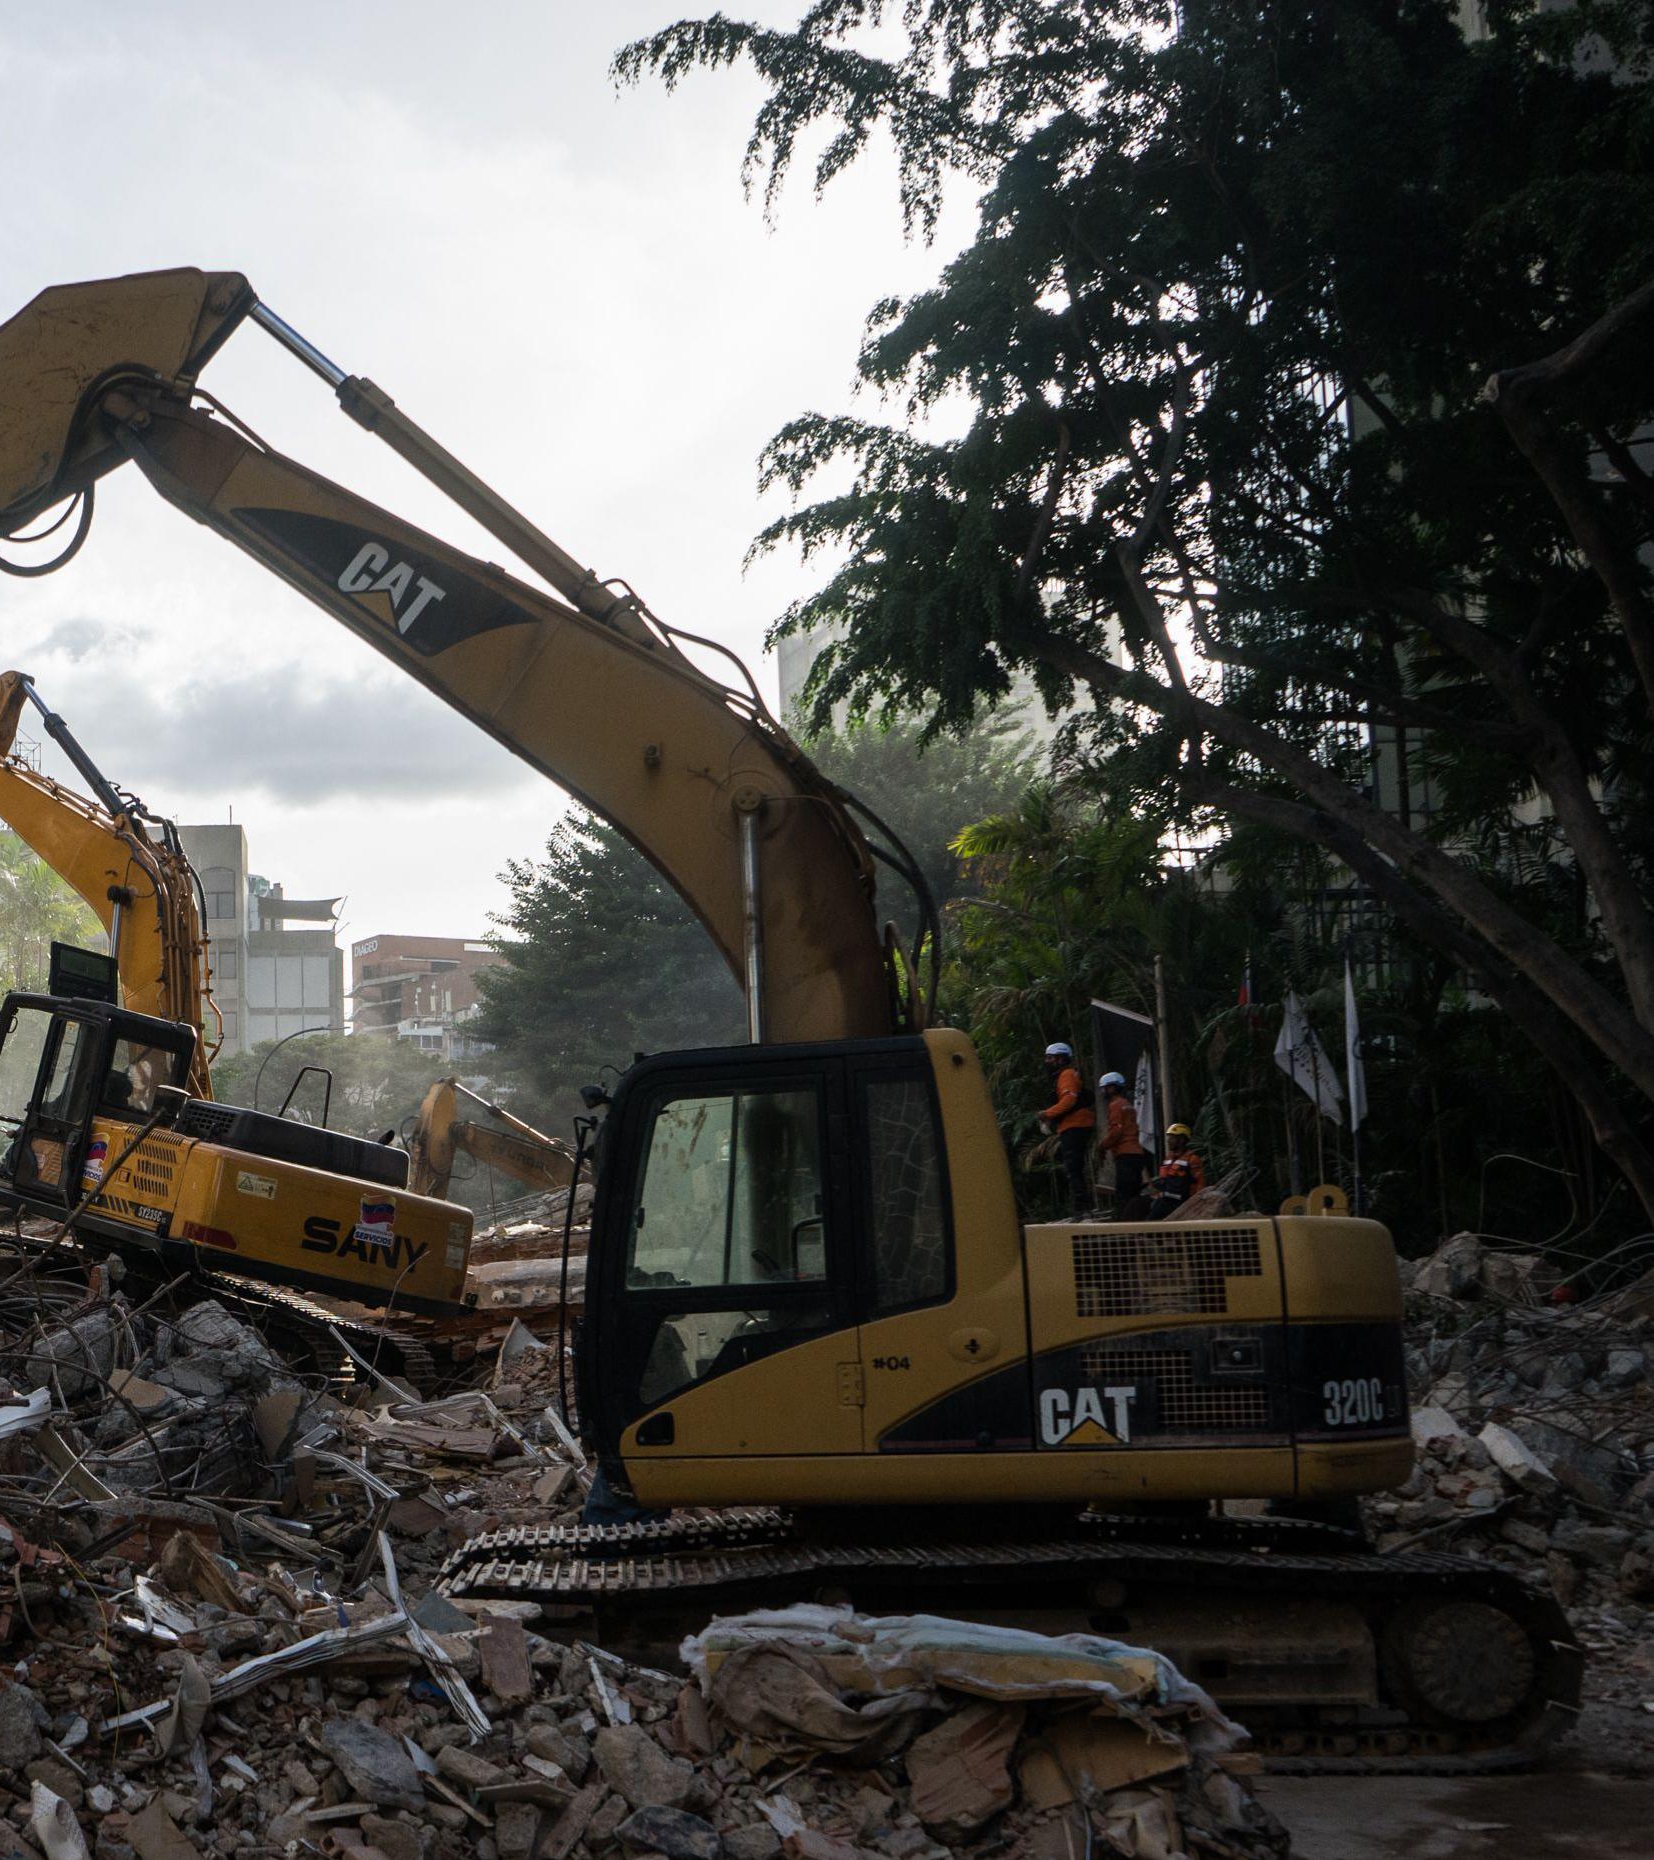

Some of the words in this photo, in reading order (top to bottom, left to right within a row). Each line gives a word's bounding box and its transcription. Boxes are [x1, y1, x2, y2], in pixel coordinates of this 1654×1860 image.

[338, 542, 446, 635] CAT
[354, 940, 378, 957] DIAGEO
[355, 1231, 393, 1246] SERVICIOS
[1040, 1387, 1136, 1445] CAT
[1322, 1377, 1384, 1426] 320C
